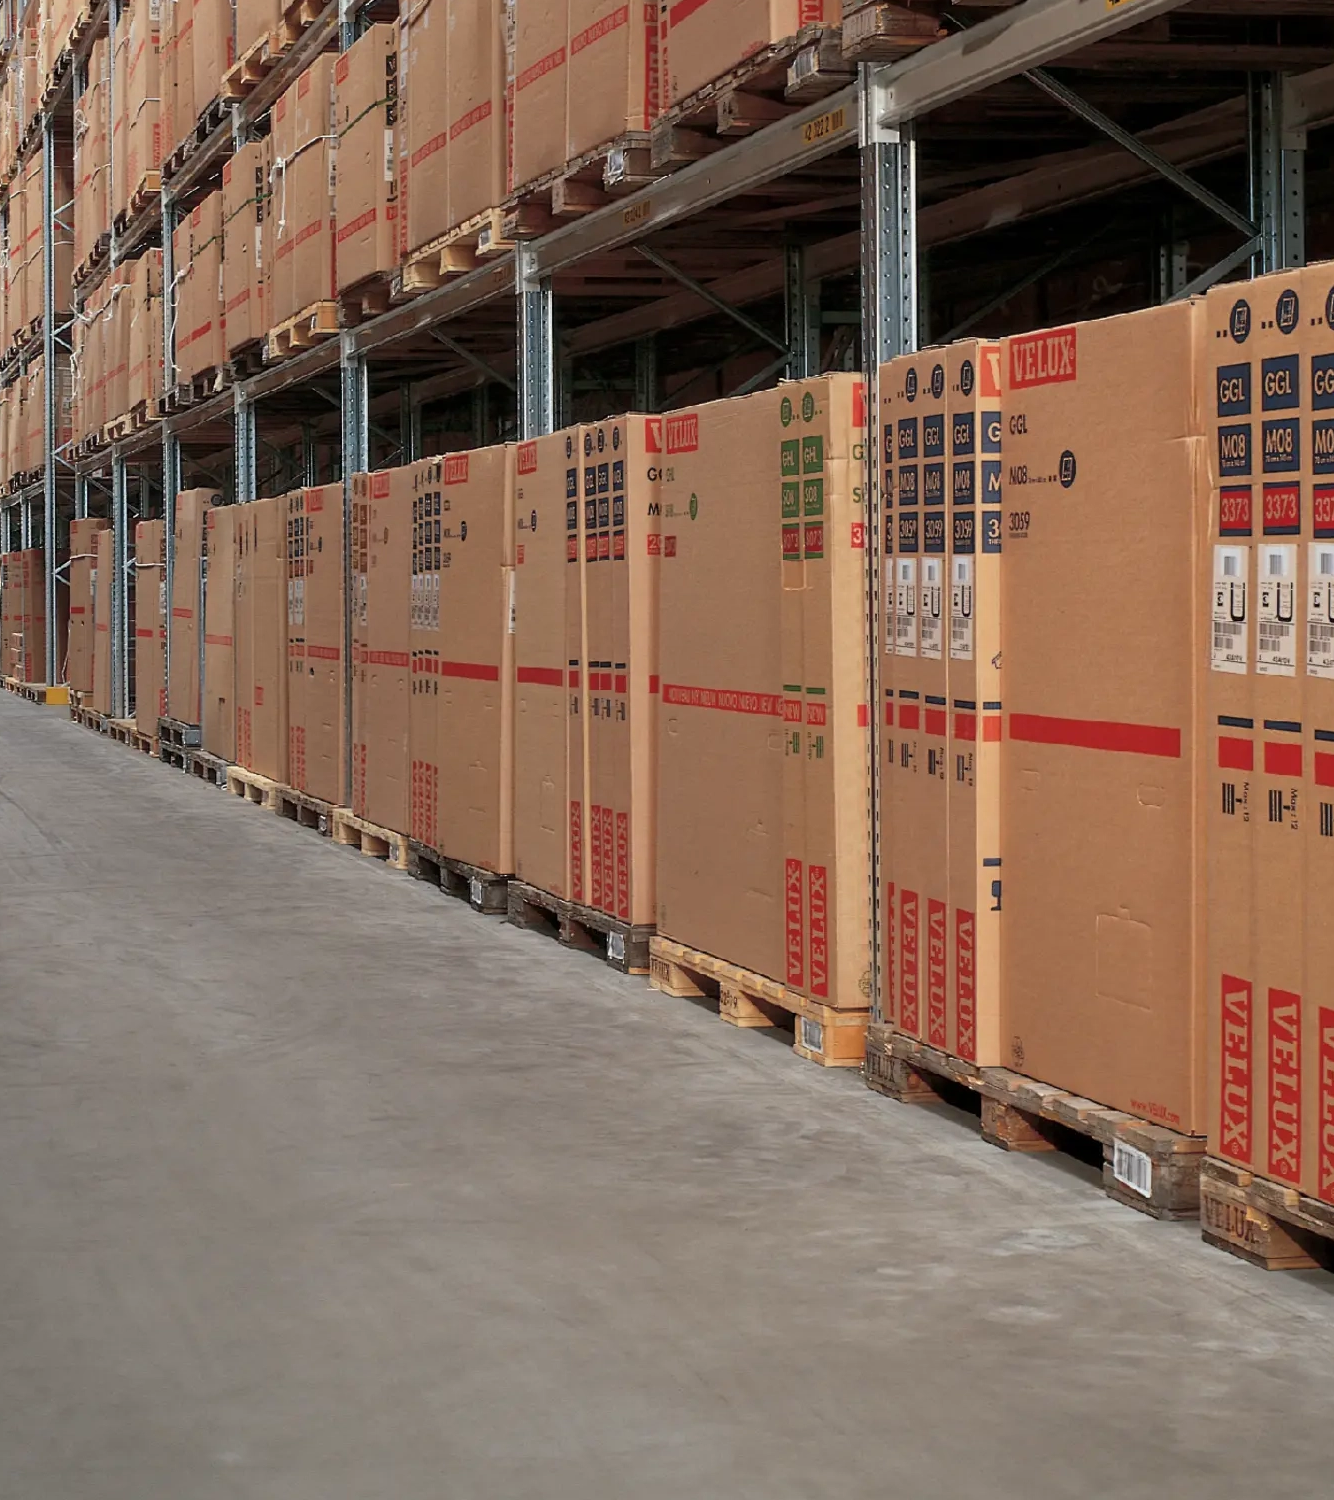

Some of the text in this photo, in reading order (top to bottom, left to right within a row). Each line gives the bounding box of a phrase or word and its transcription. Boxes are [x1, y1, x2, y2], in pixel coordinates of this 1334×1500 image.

[1013, 334, 1072, 381] VELUX
[1220, 378, 1245, 402] GGL
[1265, 370, 1292, 396] GGL
[667, 418, 697, 451] VELUX
[925, 426, 940, 446] GGL
[954, 424, 970, 445] GGL
[1009, 414, 1027, 435] GGL
[898, 429, 915, 448] GGL
[1221, 433, 1246, 459] M08
[1266, 428, 1292, 454] M08
[1009, 465, 1027, 485] M08
[1221, 493, 1250, 521] 3373
[1265, 493, 1298, 520] 3373
[1009, 511, 1030, 531] 3059
[788, 867, 801, 978] VELUX
[811, 873, 826, 988] VELUX
[902, 900, 917, 1026] VELUX
[929, 909, 944, 1039] VELUX
[958, 920, 974, 1052] VELUX
[1224, 989, 1247, 1152] VELUX
[1273, 1002, 1297, 1173] VELUX
